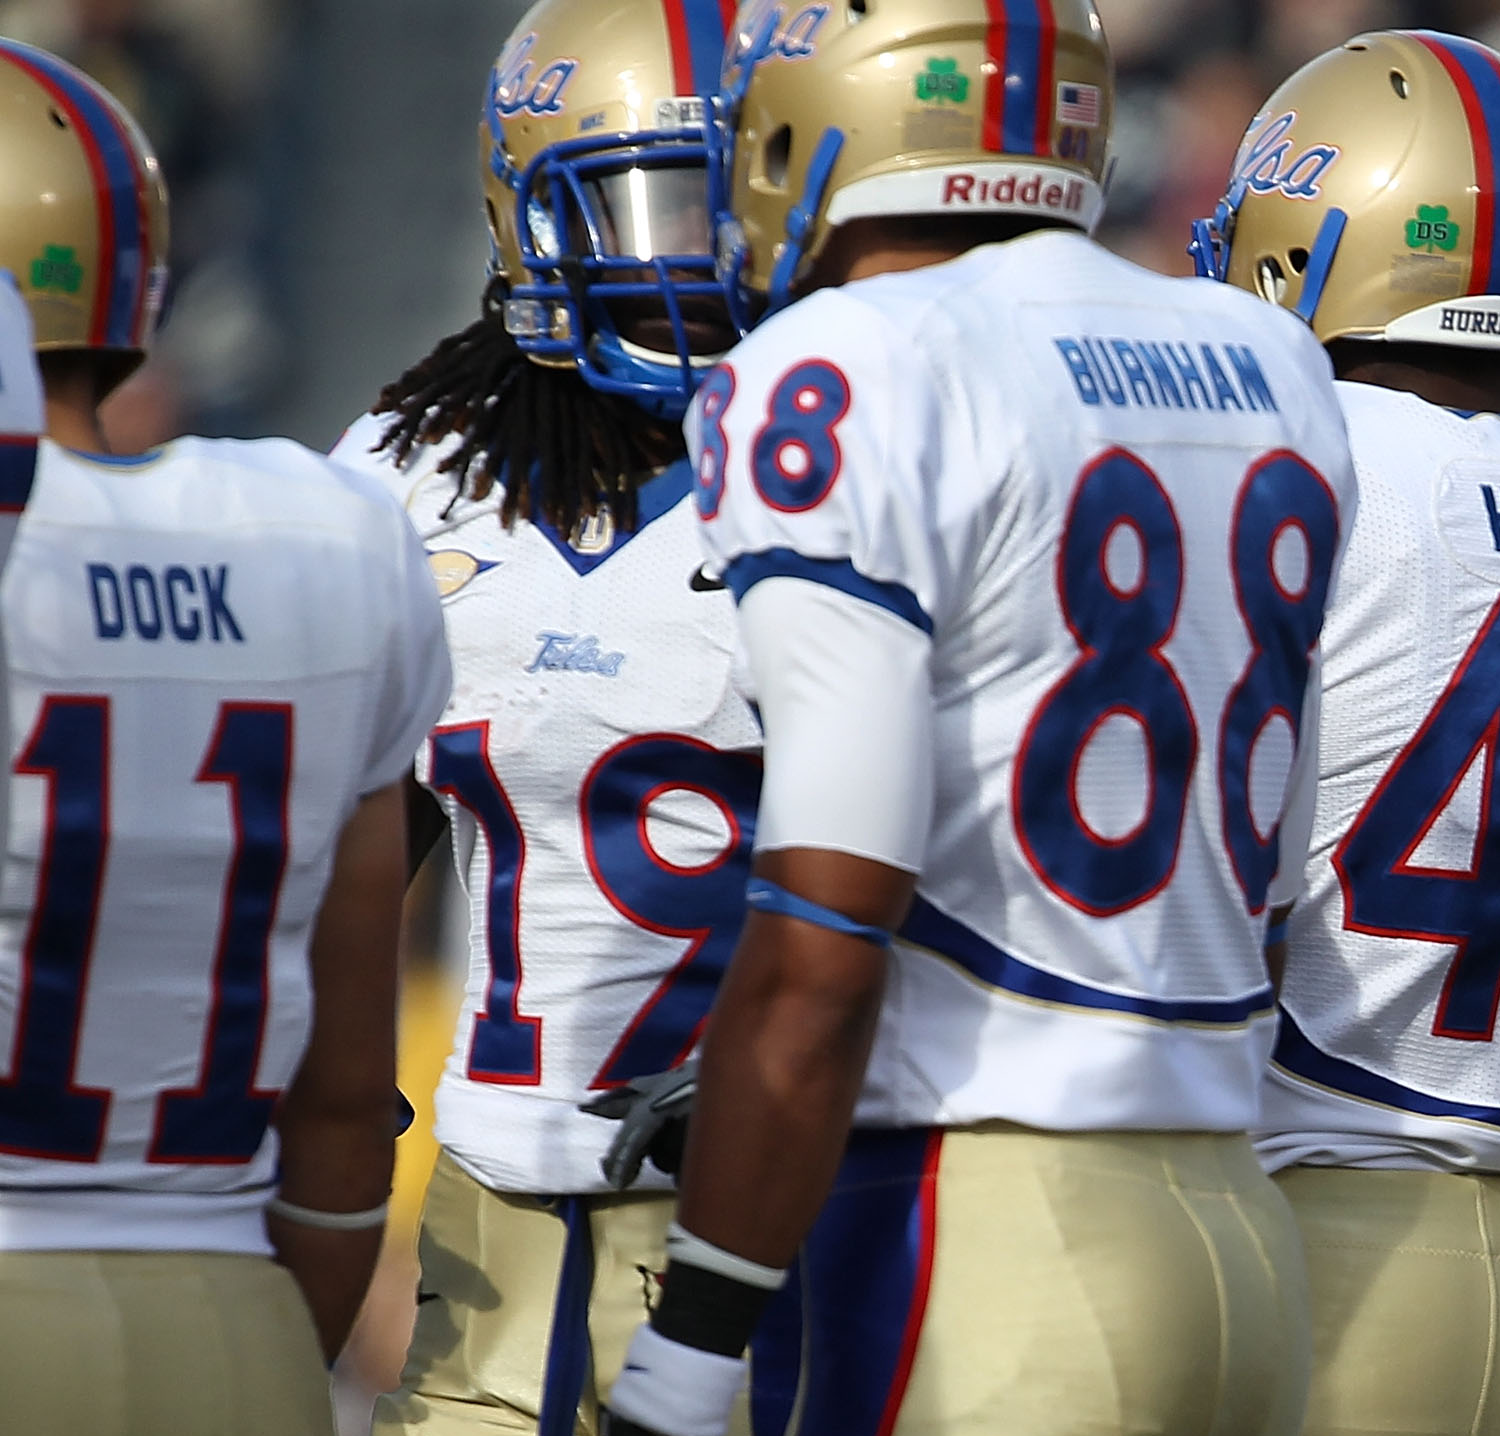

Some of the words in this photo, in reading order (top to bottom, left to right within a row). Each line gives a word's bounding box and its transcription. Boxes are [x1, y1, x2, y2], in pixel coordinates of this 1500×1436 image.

[494, 32, 579, 119] lsa
[942, 172, 1084, 211] Riddell
[1236, 108, 1341, 200] lsa
[1416, 221, 1448, 240] DS
[1052, 337, 1281, 413] BURNHAM
[86, 563, 245, 643] DOCK
[1011, 445, 1341, 917] 88
[0, 693, 294, 1165] 11
[428, 719, 764, 1092] 19
